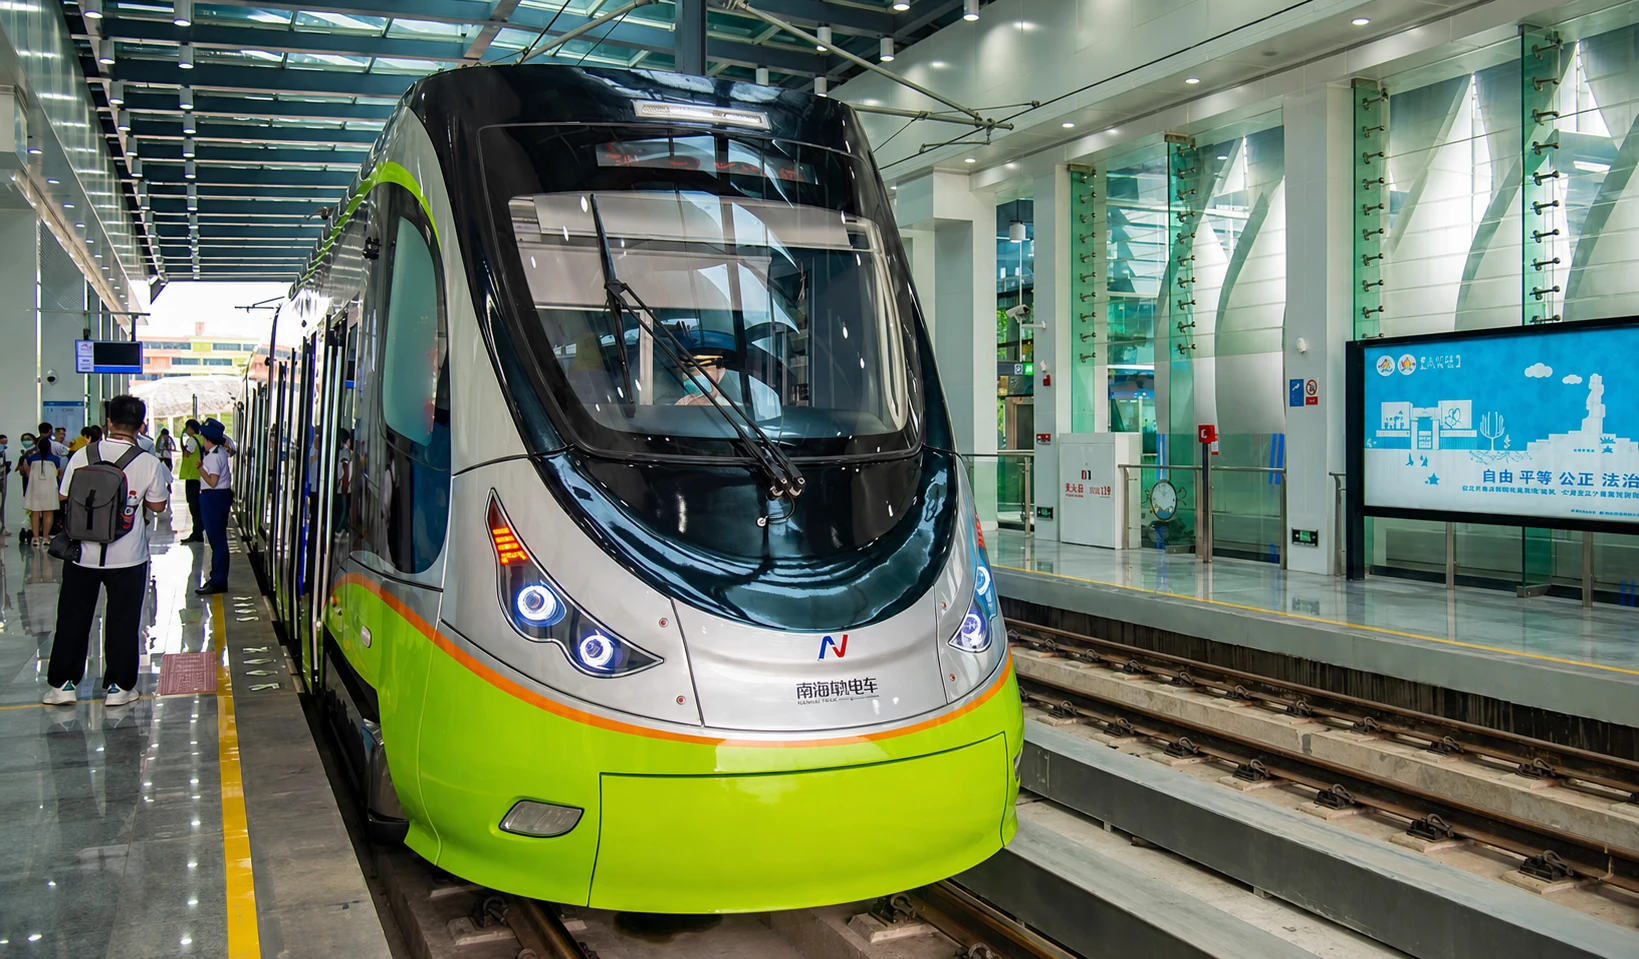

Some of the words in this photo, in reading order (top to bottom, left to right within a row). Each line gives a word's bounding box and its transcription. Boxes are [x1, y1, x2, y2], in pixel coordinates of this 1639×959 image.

[1483, 469, 1513, 484] 自由
[1519, 470, 1552, 486] 平等
[1559, 472, 1594, 487] 公正
[1602, 473, 1639, 489] 法治
